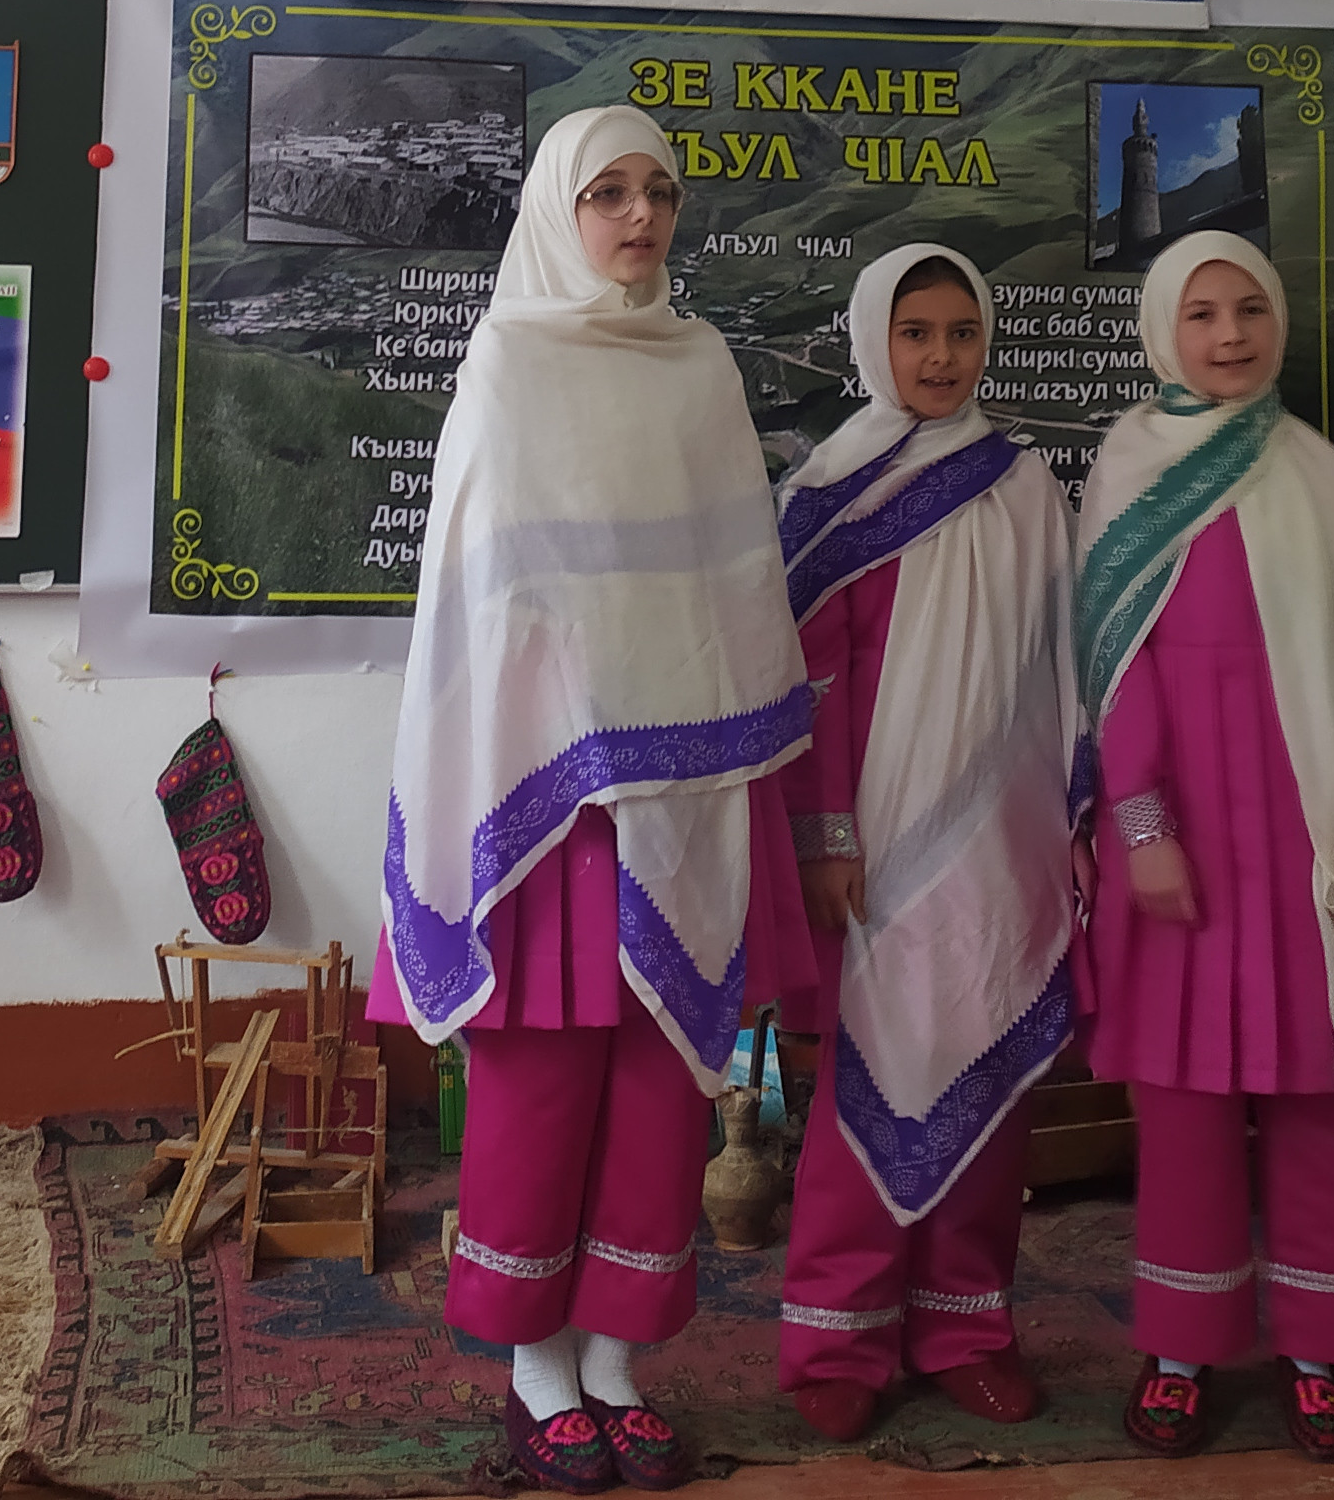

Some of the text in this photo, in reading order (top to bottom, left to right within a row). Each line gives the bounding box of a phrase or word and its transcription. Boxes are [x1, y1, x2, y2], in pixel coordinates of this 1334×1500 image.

[630, 58, 959, 116] ЗЕ ККАНЕ
[664, 131, 800, 180] ЪУЛ
[702, 233, 778, 255] АГЪУЛ
[993, 284, 1065, 309] зурна
[998, 313, 1143, 343] час баб сум
[375, 335, 405, 358] Ке
[1082, 351, 1155, 375] сума
[366, 368, 433, 392] Хьин
[1033, 381, 1108, 406] агъул
[351, 435, 438, 460] Къизи
[370, 504, 428, 534] Дар
